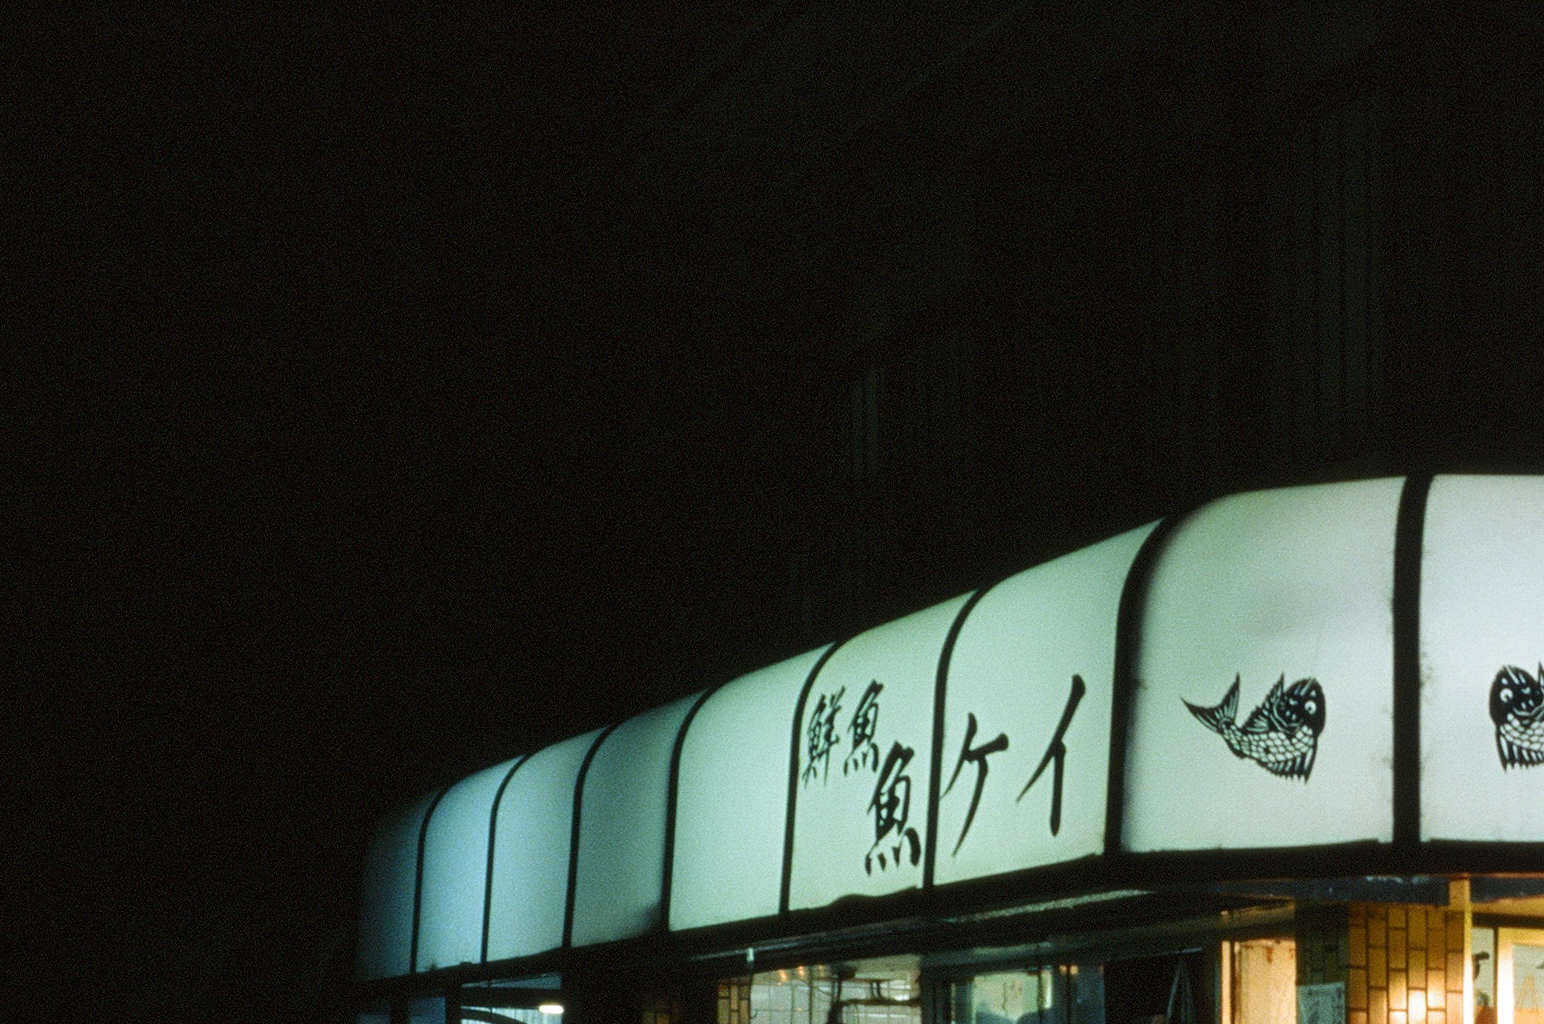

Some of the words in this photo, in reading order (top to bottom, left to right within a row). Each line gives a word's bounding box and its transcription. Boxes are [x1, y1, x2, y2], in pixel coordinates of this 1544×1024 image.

[801, 679, 885, 789] 鮮魚
[864, 673, 1087, 877] 魚ケイ
